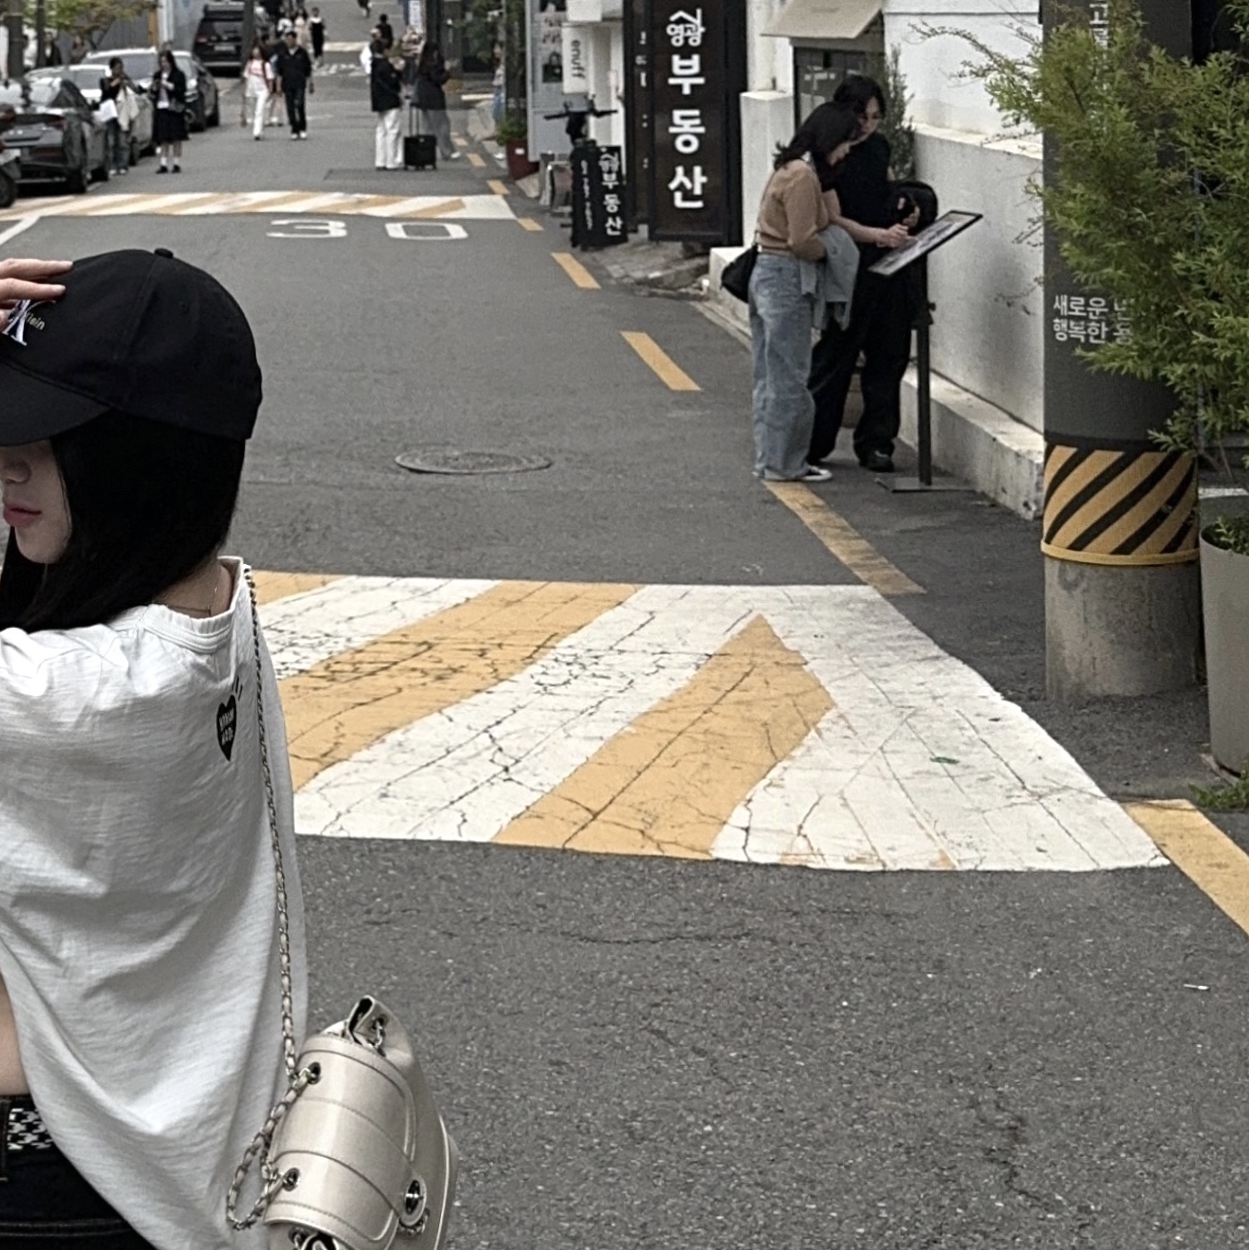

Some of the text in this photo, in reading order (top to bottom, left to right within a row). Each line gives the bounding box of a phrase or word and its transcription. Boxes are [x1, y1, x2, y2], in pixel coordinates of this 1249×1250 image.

[266, 218, 469, 241] 30
[1053, 295, 1109, 319] 새로운
[1053, 318, 1109, 344] 행복한
